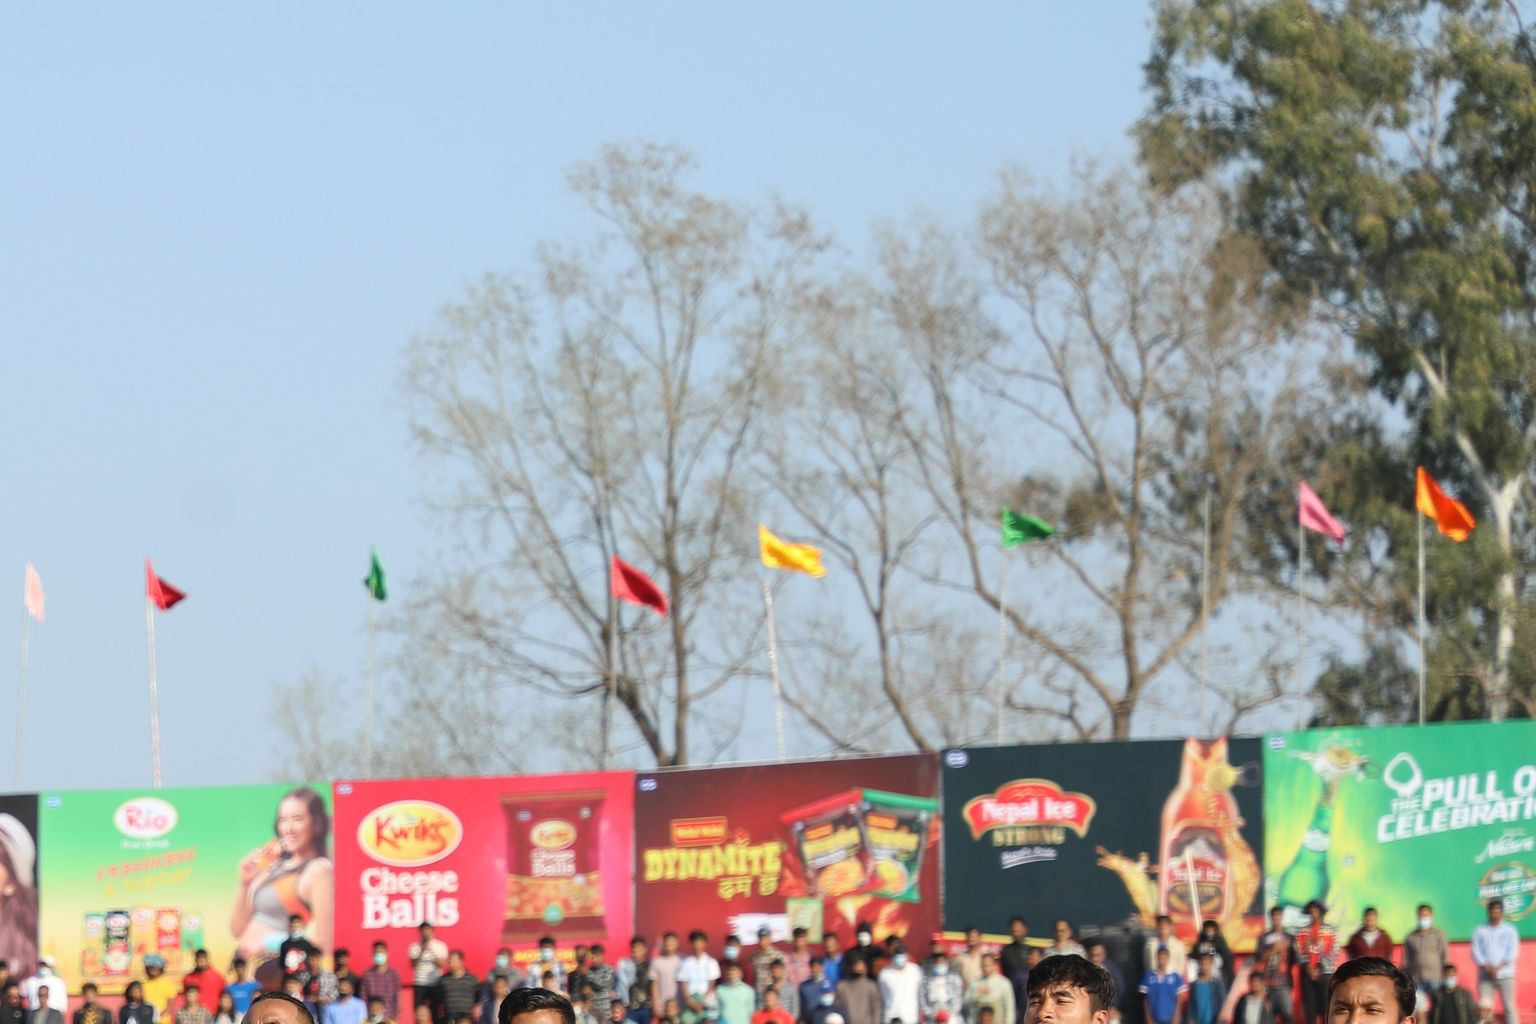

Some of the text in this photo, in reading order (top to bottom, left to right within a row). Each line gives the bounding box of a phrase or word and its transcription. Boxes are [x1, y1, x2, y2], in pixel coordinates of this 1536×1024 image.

[1422, 765, 1536, 810] PULL O
[124, 805, 169, 831] Rio
[982, 797, 1077, 825] Nepal Ice
[1376, 794, 1536, 843] CELEBRATI
[992, 826, 1065, 847] STRONG
[644, 840, 782, 883] DYNAMITE
[360, 867, 460, 894] Cheese
[361, 893, 460, 929] Balls
